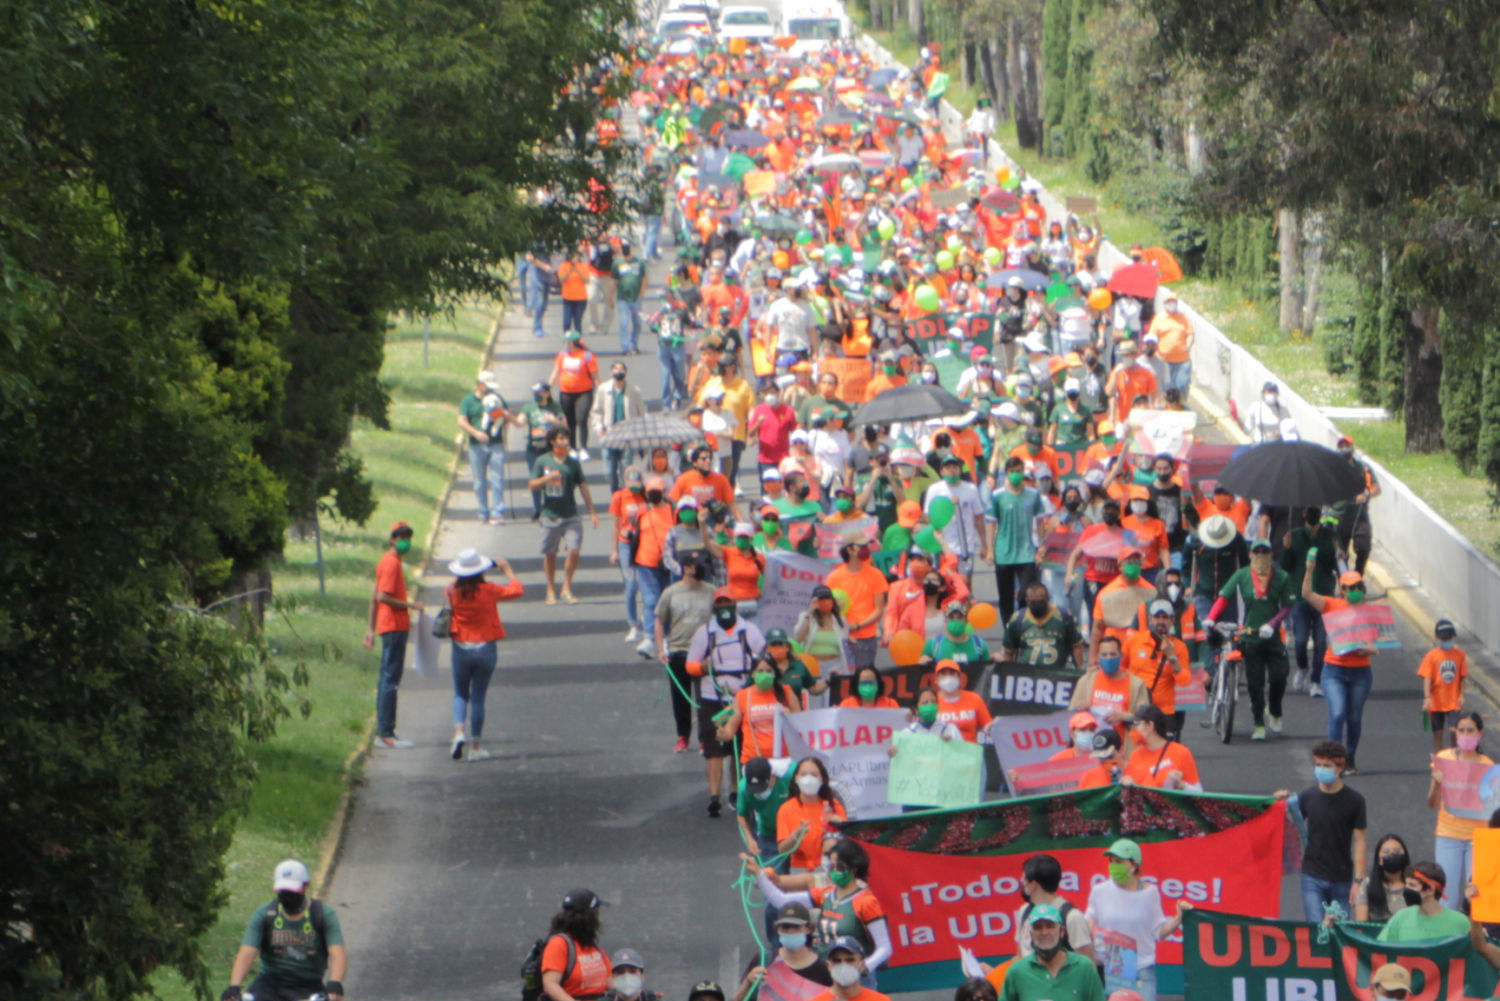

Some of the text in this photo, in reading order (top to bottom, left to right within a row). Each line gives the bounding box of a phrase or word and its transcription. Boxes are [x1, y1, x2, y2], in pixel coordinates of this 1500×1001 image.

[1027, 637, 1059, 666] 75
[990, 674, 1073, 708] LIBRE
[901, 875, 1022, 914] ¡Todo
[1060, 871, 1080, 891] a
[898, 924, 936, 947] la
[1198, 921, 1333, 969] UDL
